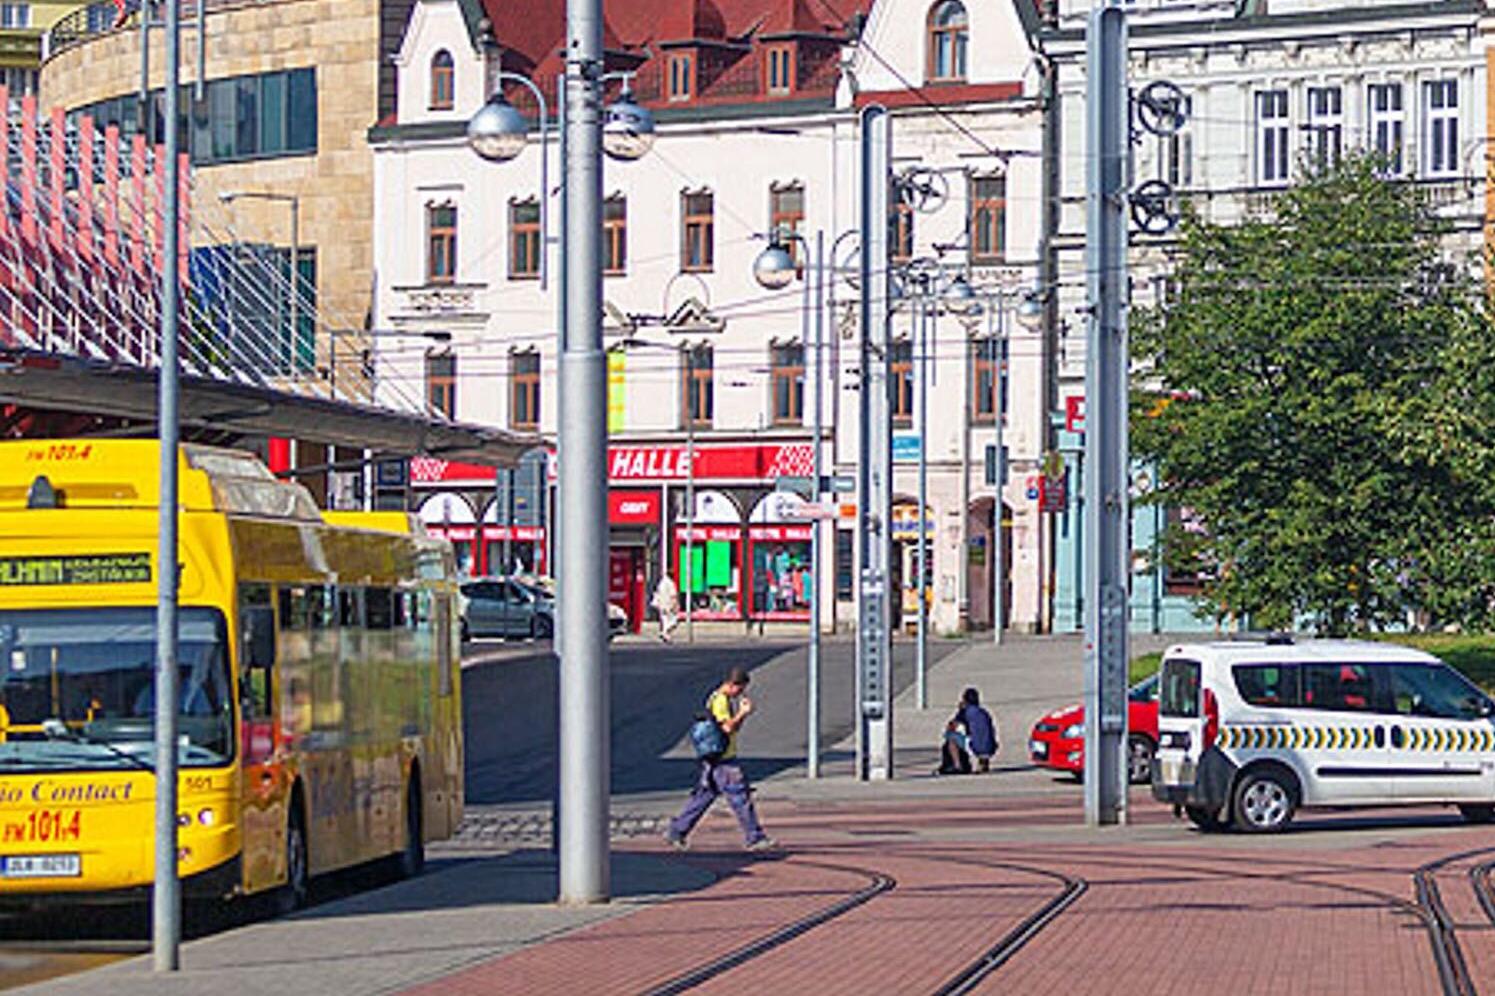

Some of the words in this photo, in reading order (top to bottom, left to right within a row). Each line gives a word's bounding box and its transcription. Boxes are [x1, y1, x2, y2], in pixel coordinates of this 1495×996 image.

[611, 451, 699, 477] HALLE
[31, 781, 133, 802] Contact
[28, 809, 82, 842] 101.4
